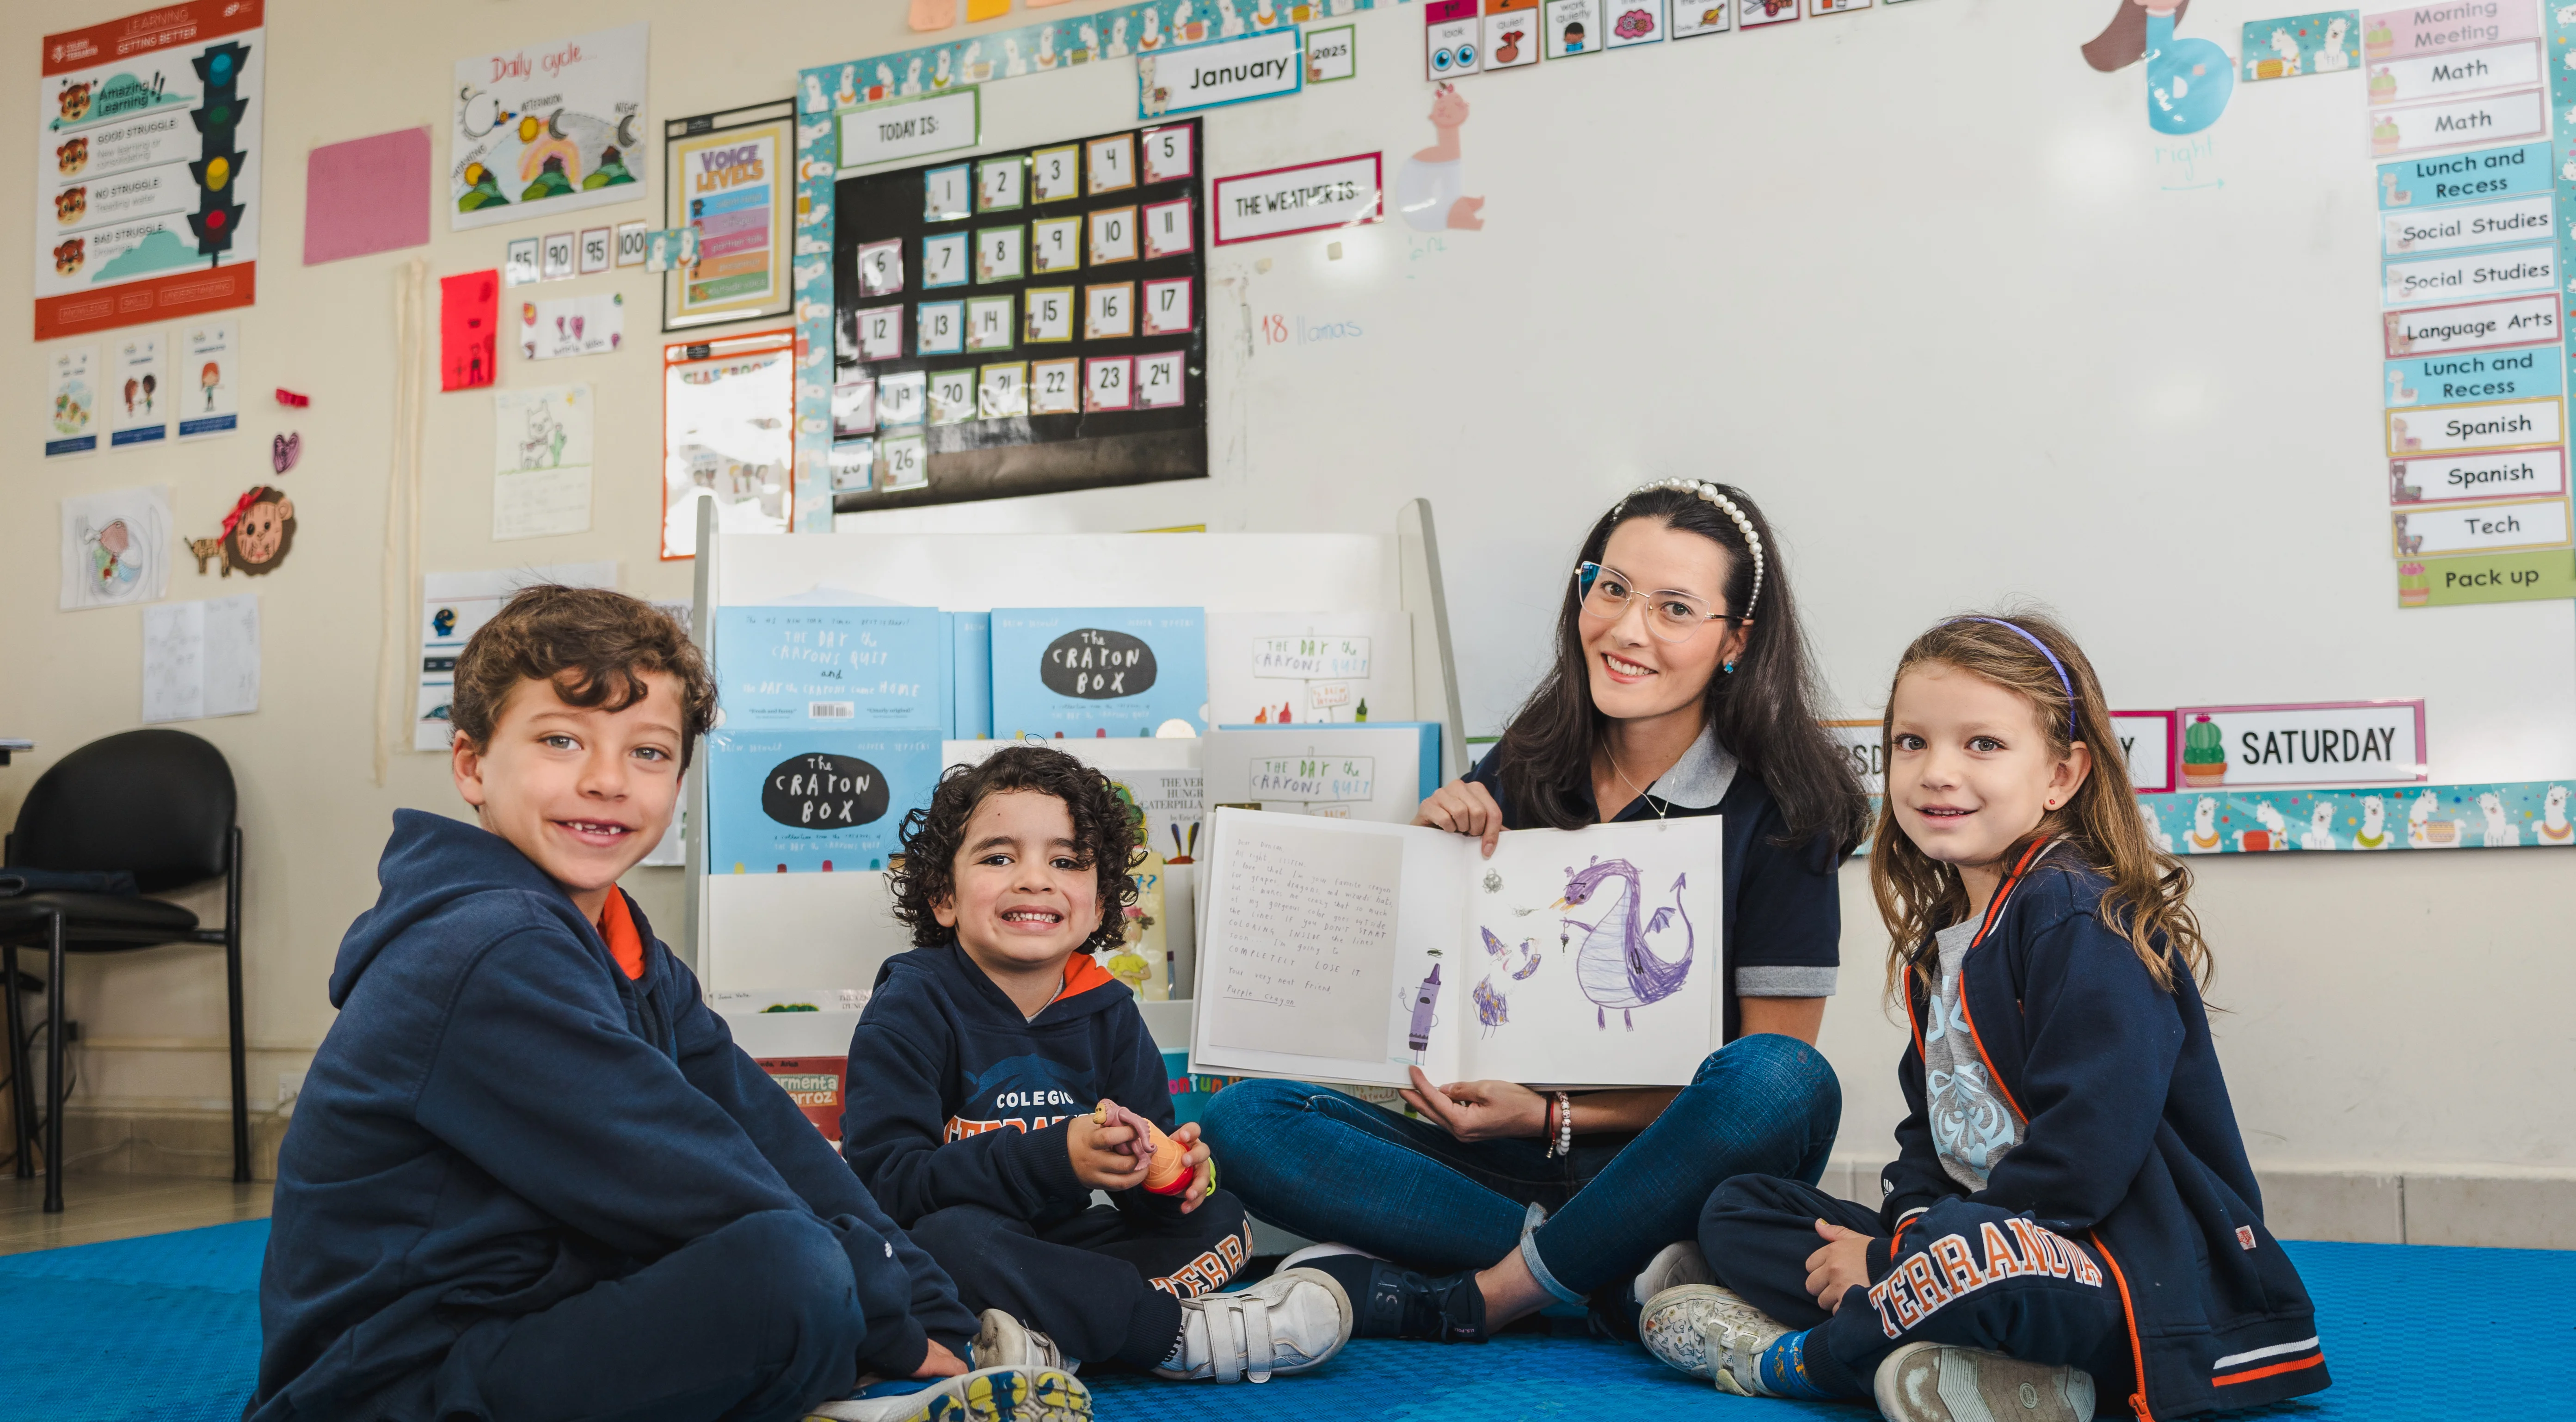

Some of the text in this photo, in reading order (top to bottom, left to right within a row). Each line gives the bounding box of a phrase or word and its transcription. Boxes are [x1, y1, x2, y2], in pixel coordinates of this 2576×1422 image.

[125, 7, 189, 35] LEARNING
[1497, 16, 1524, 30] quiet
[1555, 10, 1591, 25] quietly
[2414, 1, 2497, 26] Morning
[159, 26, 197, 44] BETTER
[1442, 27, 1465, 39] look
[2415, 24, 2499, 49] Meeting
[1314, 45, 1347, 59] 2025
[490, 51, 532, 84] Daily
[1191, 57, 1289, 89] January
[2431, 59, 2488, 83] Math
[615, 102, 639, 113] NIGHT
[879, 116, 939, 142] TODAY IS:
[2435, 110, 2492, 133] Math
[701, 145, 759, 172] VOICE
[1164, 137, 1174, 158] 5
[2154, 134, 2215, 181] right
[1051, 159, 1061, 180] 3
[1107, 148, 1116, 170] 4
[2417, 149, 2525, 178] Lunch and
[696, 159, 764, 193] LEVELS
[997, 172, 1007, 192] 2
[946, 180, 951, 201] 1
[2437, 178, 2508, 198] Recess
[1236, 196, 1262, 218] THE
[1265, 184, 1333, 212] WEATHER
[1104, 220, 1121, 243] 10
[1165, 211, 1173, 233] 11
[2403, 213, 2548, 242] Social Studies
[587, 239, 604, 262] 95
[620, 232, 644, 256] 100
[996, 240, 1005, 261] 8
[1052, 230, 1063, 250] 9
[549, 244, 568, 266] 90
[877, 252, 886, 272] 6
[942, 247, 951, 269] 7
[2404, 264, 2550, 291] Social Studies
[1043, 300, 1057, 322] 15
[1103, 296, 1118, 319] 16
[1161, 289, 1175, 311] 17
[873, 319, 886, 340] 12
[934, 315, 948, 337] 13
[984, 310, 997, 332] 14
[1261, 314, 1363, 346] 18 llamas
[2407, 313, 2552, 341] Language Arts
[1150, 363, 1170, 385] 24
[2423, 353, 2533, 377] Lunch and
[1046, 372, 1065, 393] 22
[1100, 367, 1120, 388] 23
[943, 383, 963, 405] 20
[2443, 381, 2515, 398] Recess
[2446, 415, 2532, 440] Spanish
[894, 448, 914, 471] 26
[2447, 463, 2534, 489] Spanish
[2464, 515, 2521, 534] Tech
[2446, 570, 2539, 588] Pack up
[785, 630, 877, 648] THE DAY the
[1081, 630, 1105, 646] The
[1267, 639, 1357, 656] THE DAY the
[772, 646, 888, 669] CRAYONS QUIT
[1052, 647, 1140, 668] CRAYON
[1254, 653, 1367, 677] CRAYONS QUIT
[821, 669, 842, 680] and
[1076, 672, 1125, 694] BOX
[2242, 726, 2396, 766] SATURDAY
[807, 755, 833, 771] The
[1265, 760, 1359, 778] THE DAY the
[776, 773, 870, 797] CRAYON
[1160, 778, 1203, 787] THE VER
[1167, 789, 1204, 798] HUNGR
[1252, 774, 1370, 800] CRAYONS QUIT
[801, 799, 854, 824] BOX
[1141, 800, 1203, 809] CATERPILLA
[1243, 862, 1255, 870] love
[1267, 866, 1283, 875] that
[1368, 884, 1391, 894] crayon
[1269, 901, 1325, 918] gorgeous color
[1308, 897, 1328, 908] crazy
[1334, 901, 1349, 910] that
[1369, 908, 1387, 916] much
[1289, 929, 1320, 940] INSIDE
[1353, 937, 1373, 946] lines
[1301, 919, 1317, 929] you
[1359, 927, 1386, 938] START
[1273, 938, 1320, 955] I'm going
[1229, 945, 1340, 973] COMPLETELY LOSE
[1229, 966, 1243, 976] Your
[1255, 973, 1271, 984] very
[1227, 984, 1252, 997] Purple
[773, 1076, 837, 1090] ormenta
[997, 1091, 1074, 1109] COLEGIO
[1148, 1217, 1254, 1299] TERRA
[1868, 1217, 2103, 1340] TERRANOVA
